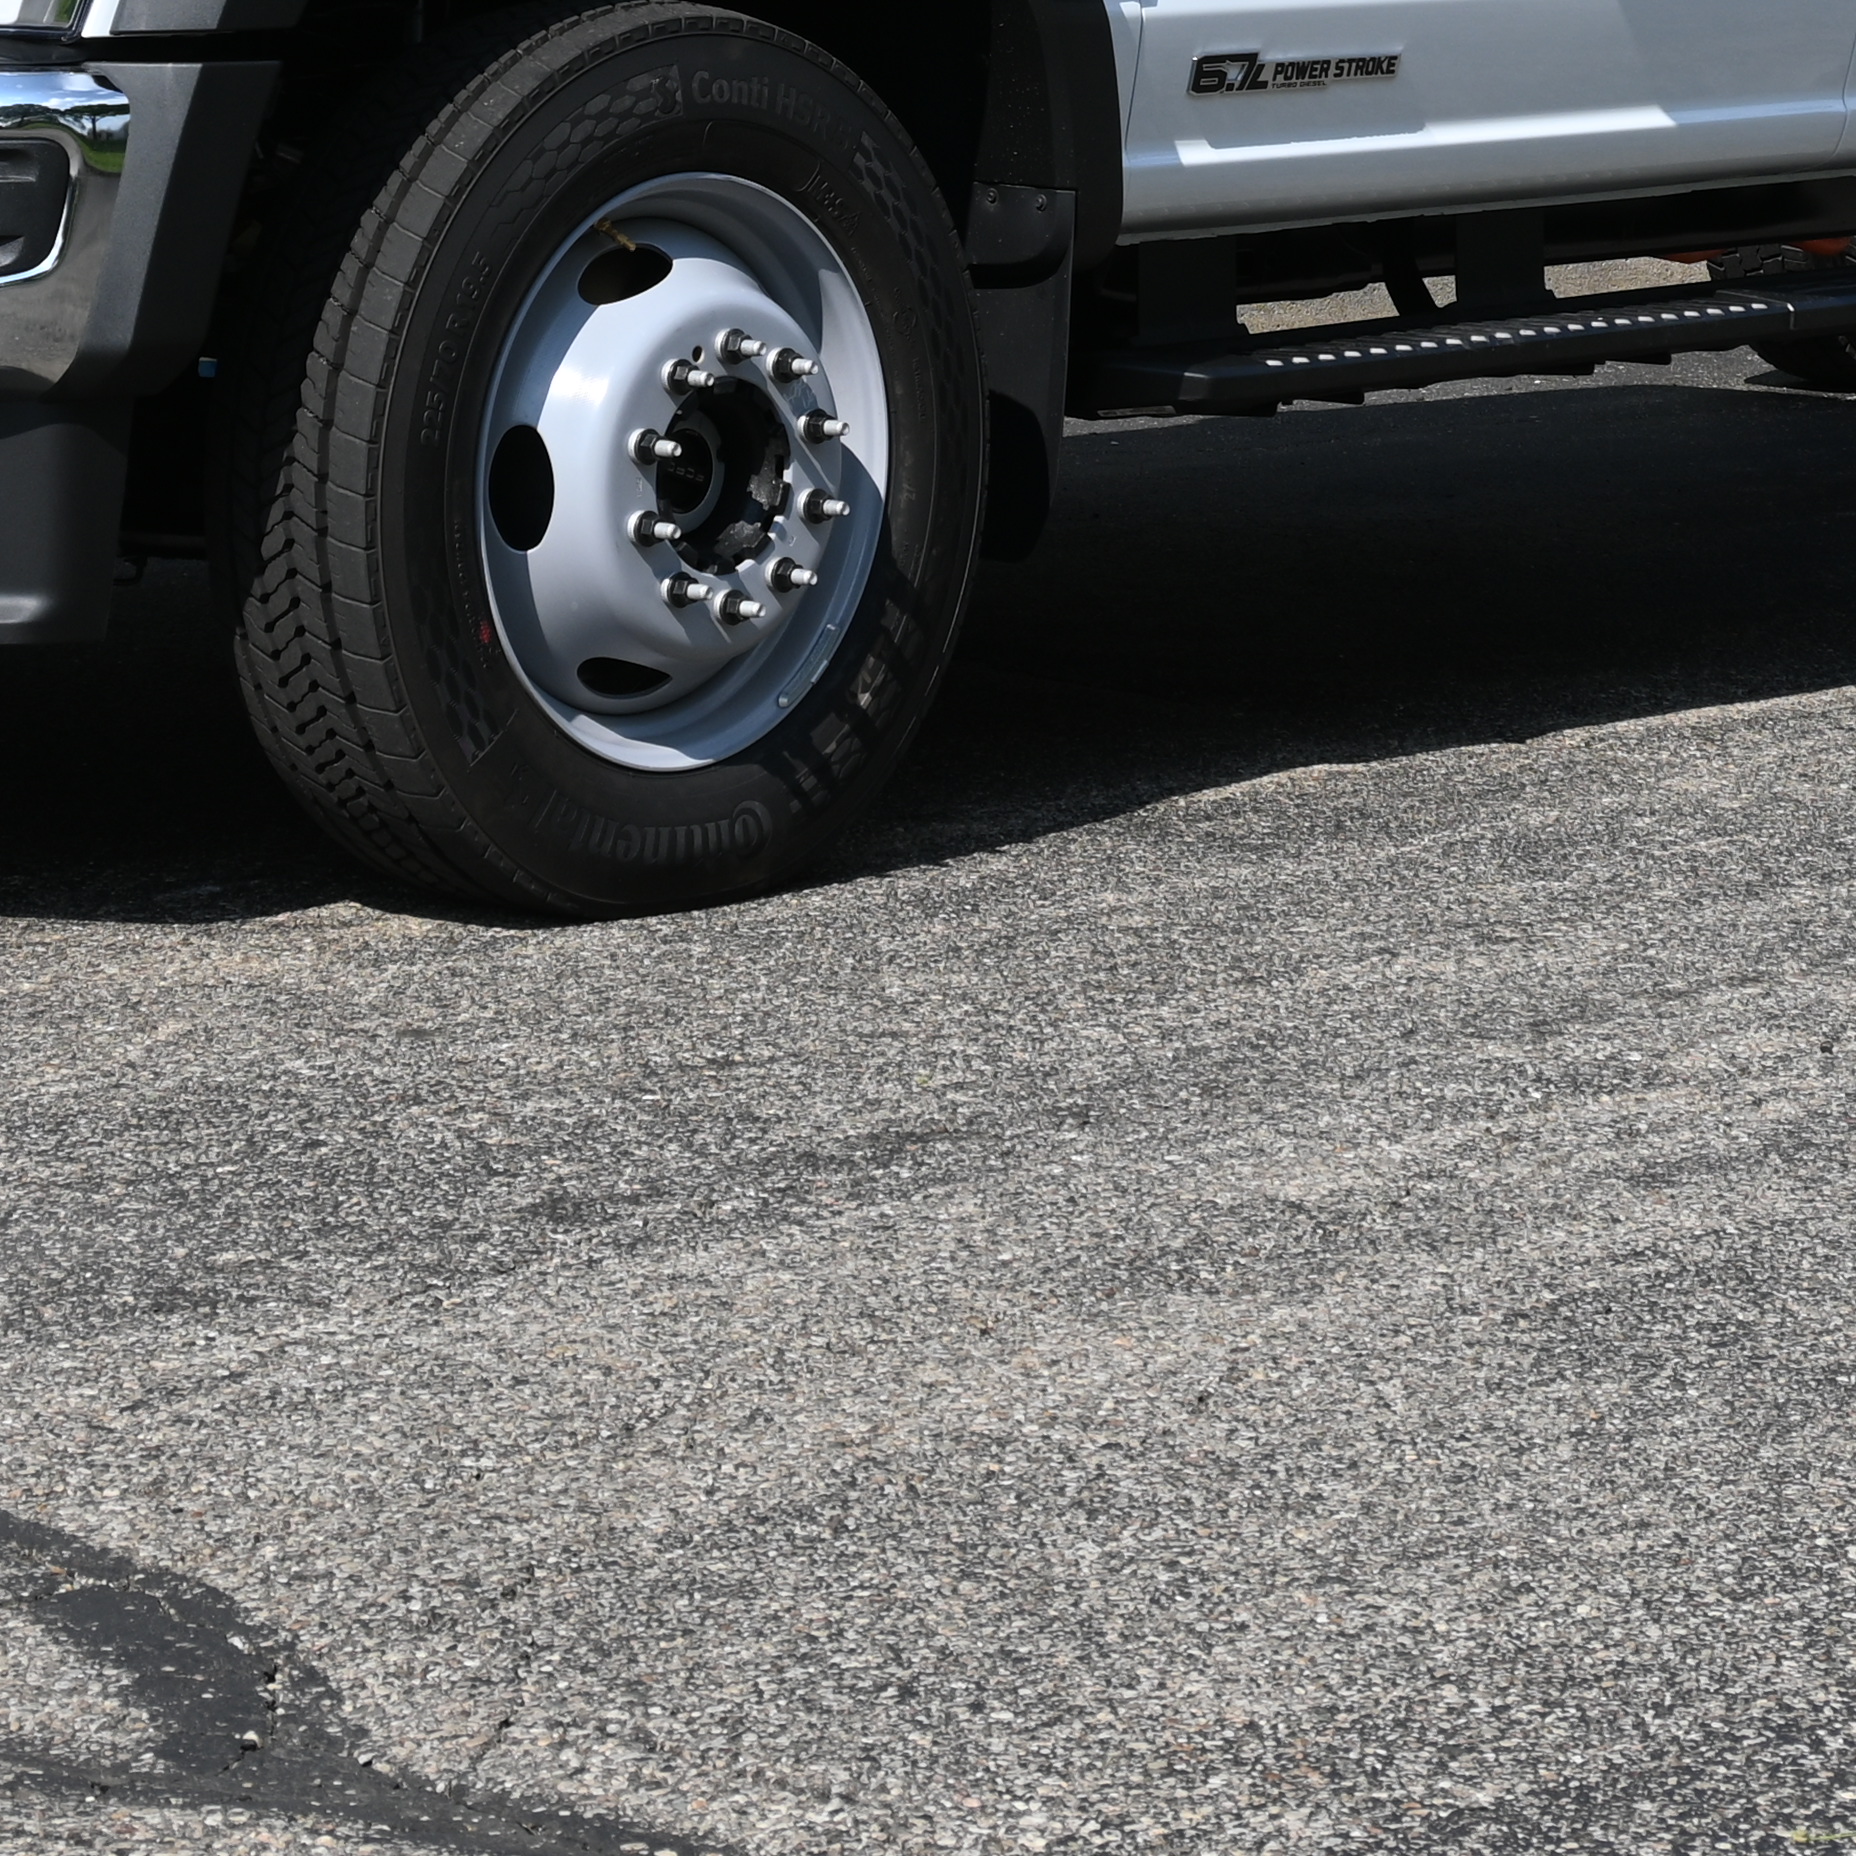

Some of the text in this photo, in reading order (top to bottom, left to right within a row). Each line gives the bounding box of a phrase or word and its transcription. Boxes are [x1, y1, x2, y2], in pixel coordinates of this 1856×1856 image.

[691, 69, 769, 110] Conti
[1191, 53, 1398, 94] 6.7L POWER STROKE
[1299, 80, 1327, 88] DIESEL
[420, 340, 459, 448] 225/70
[456, 251, 493, 312] 19.5
[534, 789, 773, 865] Continental
